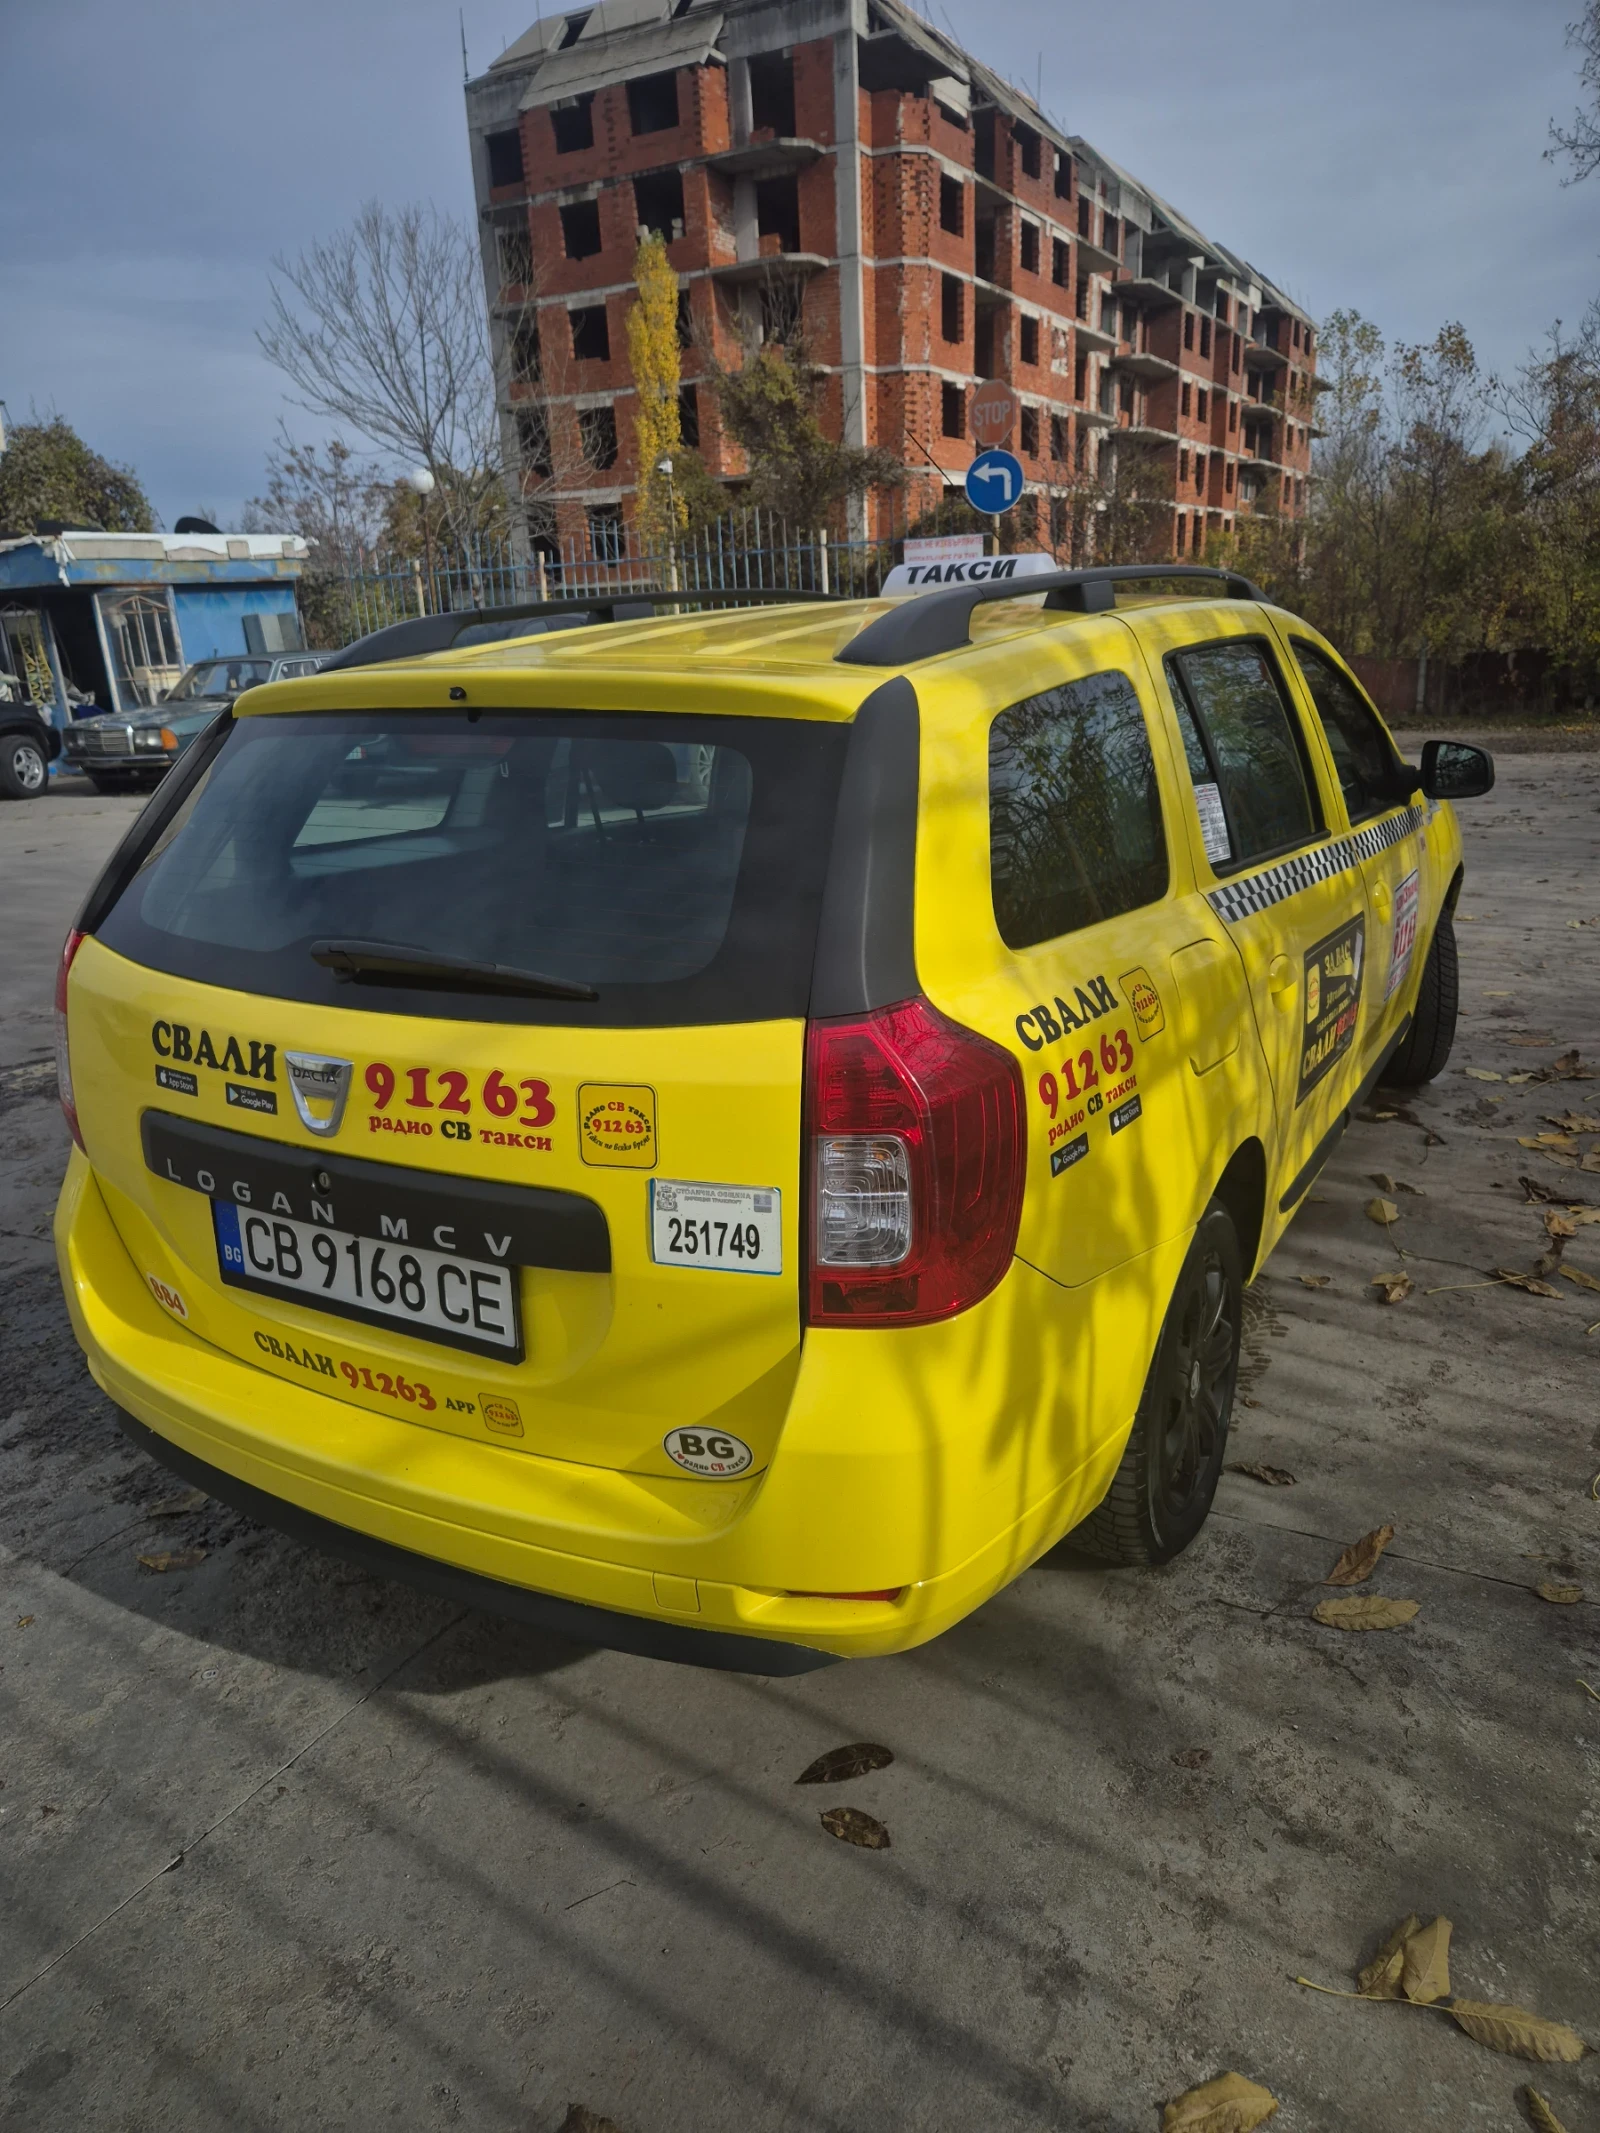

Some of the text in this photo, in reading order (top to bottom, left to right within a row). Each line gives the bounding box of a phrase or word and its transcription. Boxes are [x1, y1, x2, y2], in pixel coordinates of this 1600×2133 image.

[973, 400, 1011, 426] STOP
[907, 559, 1018, 585] ТАКСИ
[1015, 975, 1119, 1052] СВАЛИ
[152, 1020, 277, 1082] СВАЛИ
[169, 1078, 194, 1091] App Store
[292, 1067, 337, 1084] DACIA
[240, 1095, 274, 1111] Google Play
[584, 1101, 652, 1132] радио СВ такси
[1048, 1109, 1085, 1146] радио
[1087, 1092, 1104, 1116] СВ
[1106, 1075, 1137, 1104] такси
[368, 1114, 553, 1151] радио СВ такси
[166, 1158, 512, 1258] LOGAN MCV
[224, 1244, 242, 1263] BG
[668, 1217, 760, 1260] 251749
[149, 1277, 186, 1316] 884
[253, 1331, 475, 1415] СВАЛИ 91263 APP
[679, 1433, 735, 1459] BG
[683, 1458, 709, 1471] радио
[710, 1463, 725, 1471] СВ
[727, 1456, 746, 1471] такси
